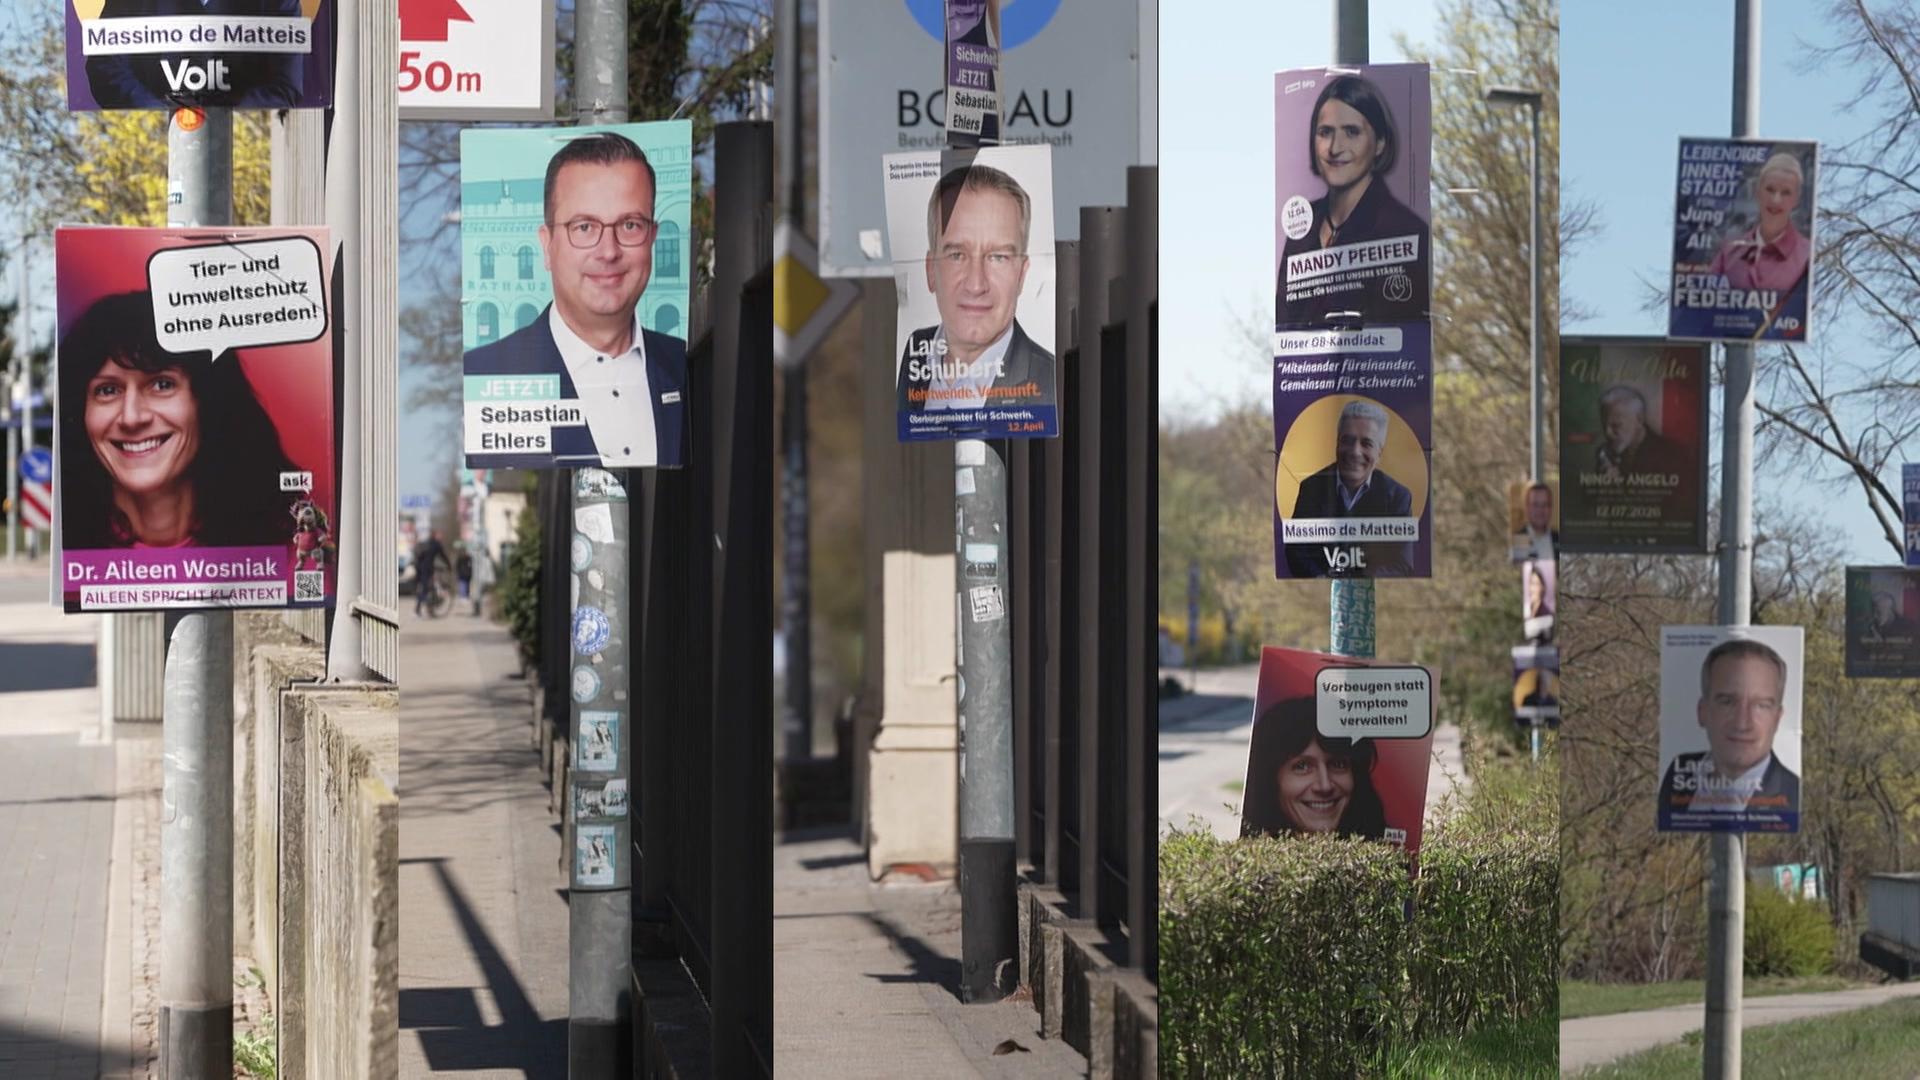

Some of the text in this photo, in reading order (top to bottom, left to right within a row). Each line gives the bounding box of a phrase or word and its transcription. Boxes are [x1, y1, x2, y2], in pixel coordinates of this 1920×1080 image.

[88, 24, 307, 46] Massimo de Matteis
[160, 59, 231, 91] Volt
[956, 68, 988, 87] JETZT!
[954, 92, 998, 111] Sebastian
[953, 114, 980, 132] Ehlers
[1682, 146, 1767, 162] LEBENDIGE
[1681, 162, 1743, 179] INNEN-
[1680, 180, 1738, 196] STADT
[1680, 207, 1724, 227] Jung
[1686, 232, 1712, 249] Alt
[190, 254, 280, 279] Tier- und
[1290, 241, 1414, 276] MANDY PFEIFER
[467, 280, 546, 292] RATHAUS
[1674, 274, 1730, 290] PETRA
[168, 281, 308, 307] Umweltschutz
[1674, 288, 1777, 310] FEDERAU
[164, 303, 318, 334] ohne Ausreden!
[1774, 317, 1799, 330] AfD
[910, 336, 949, 357] Lars
[1281, 334, 1385, 349] Unser OB-Kandidat
[908, 357, 1005, 382] Schubert
[1341, 358, 1416, 373] füreinander.
[480, 379, 554, 397] JETZT!
[1280, 378, 1335, 391] Gemeinsam
[1336, 376, 1356, 391] für
[481, 404, 580, 423] Sebastian
[975, 410, 988, 422] für
[989, 410, 1034, 421] Schwerin.
[481, 432, 546, 450] Ehlers
[283, 475, 308, 488] ask
[1626, 473, 1680, 487] ANGELO
[1285, 523, 1415, 537] Massimo de Matteis
[1323, 547, 1366, 568] Volt
[67, 557, 278, 581] Dr. Aileen Wosniak
[85, 587, 284, 604] AILEEN SPRICHT KLARTEXT
[1322, 680, 1424, 695] Vorbeugen statt
[1339, 698, 1408, 711] Symptome
[1340, 715, 1408, 726] verwalten!
[1674, 757, 1714, 774] Lars
[1672, 773, 1763, 791] Schubert
